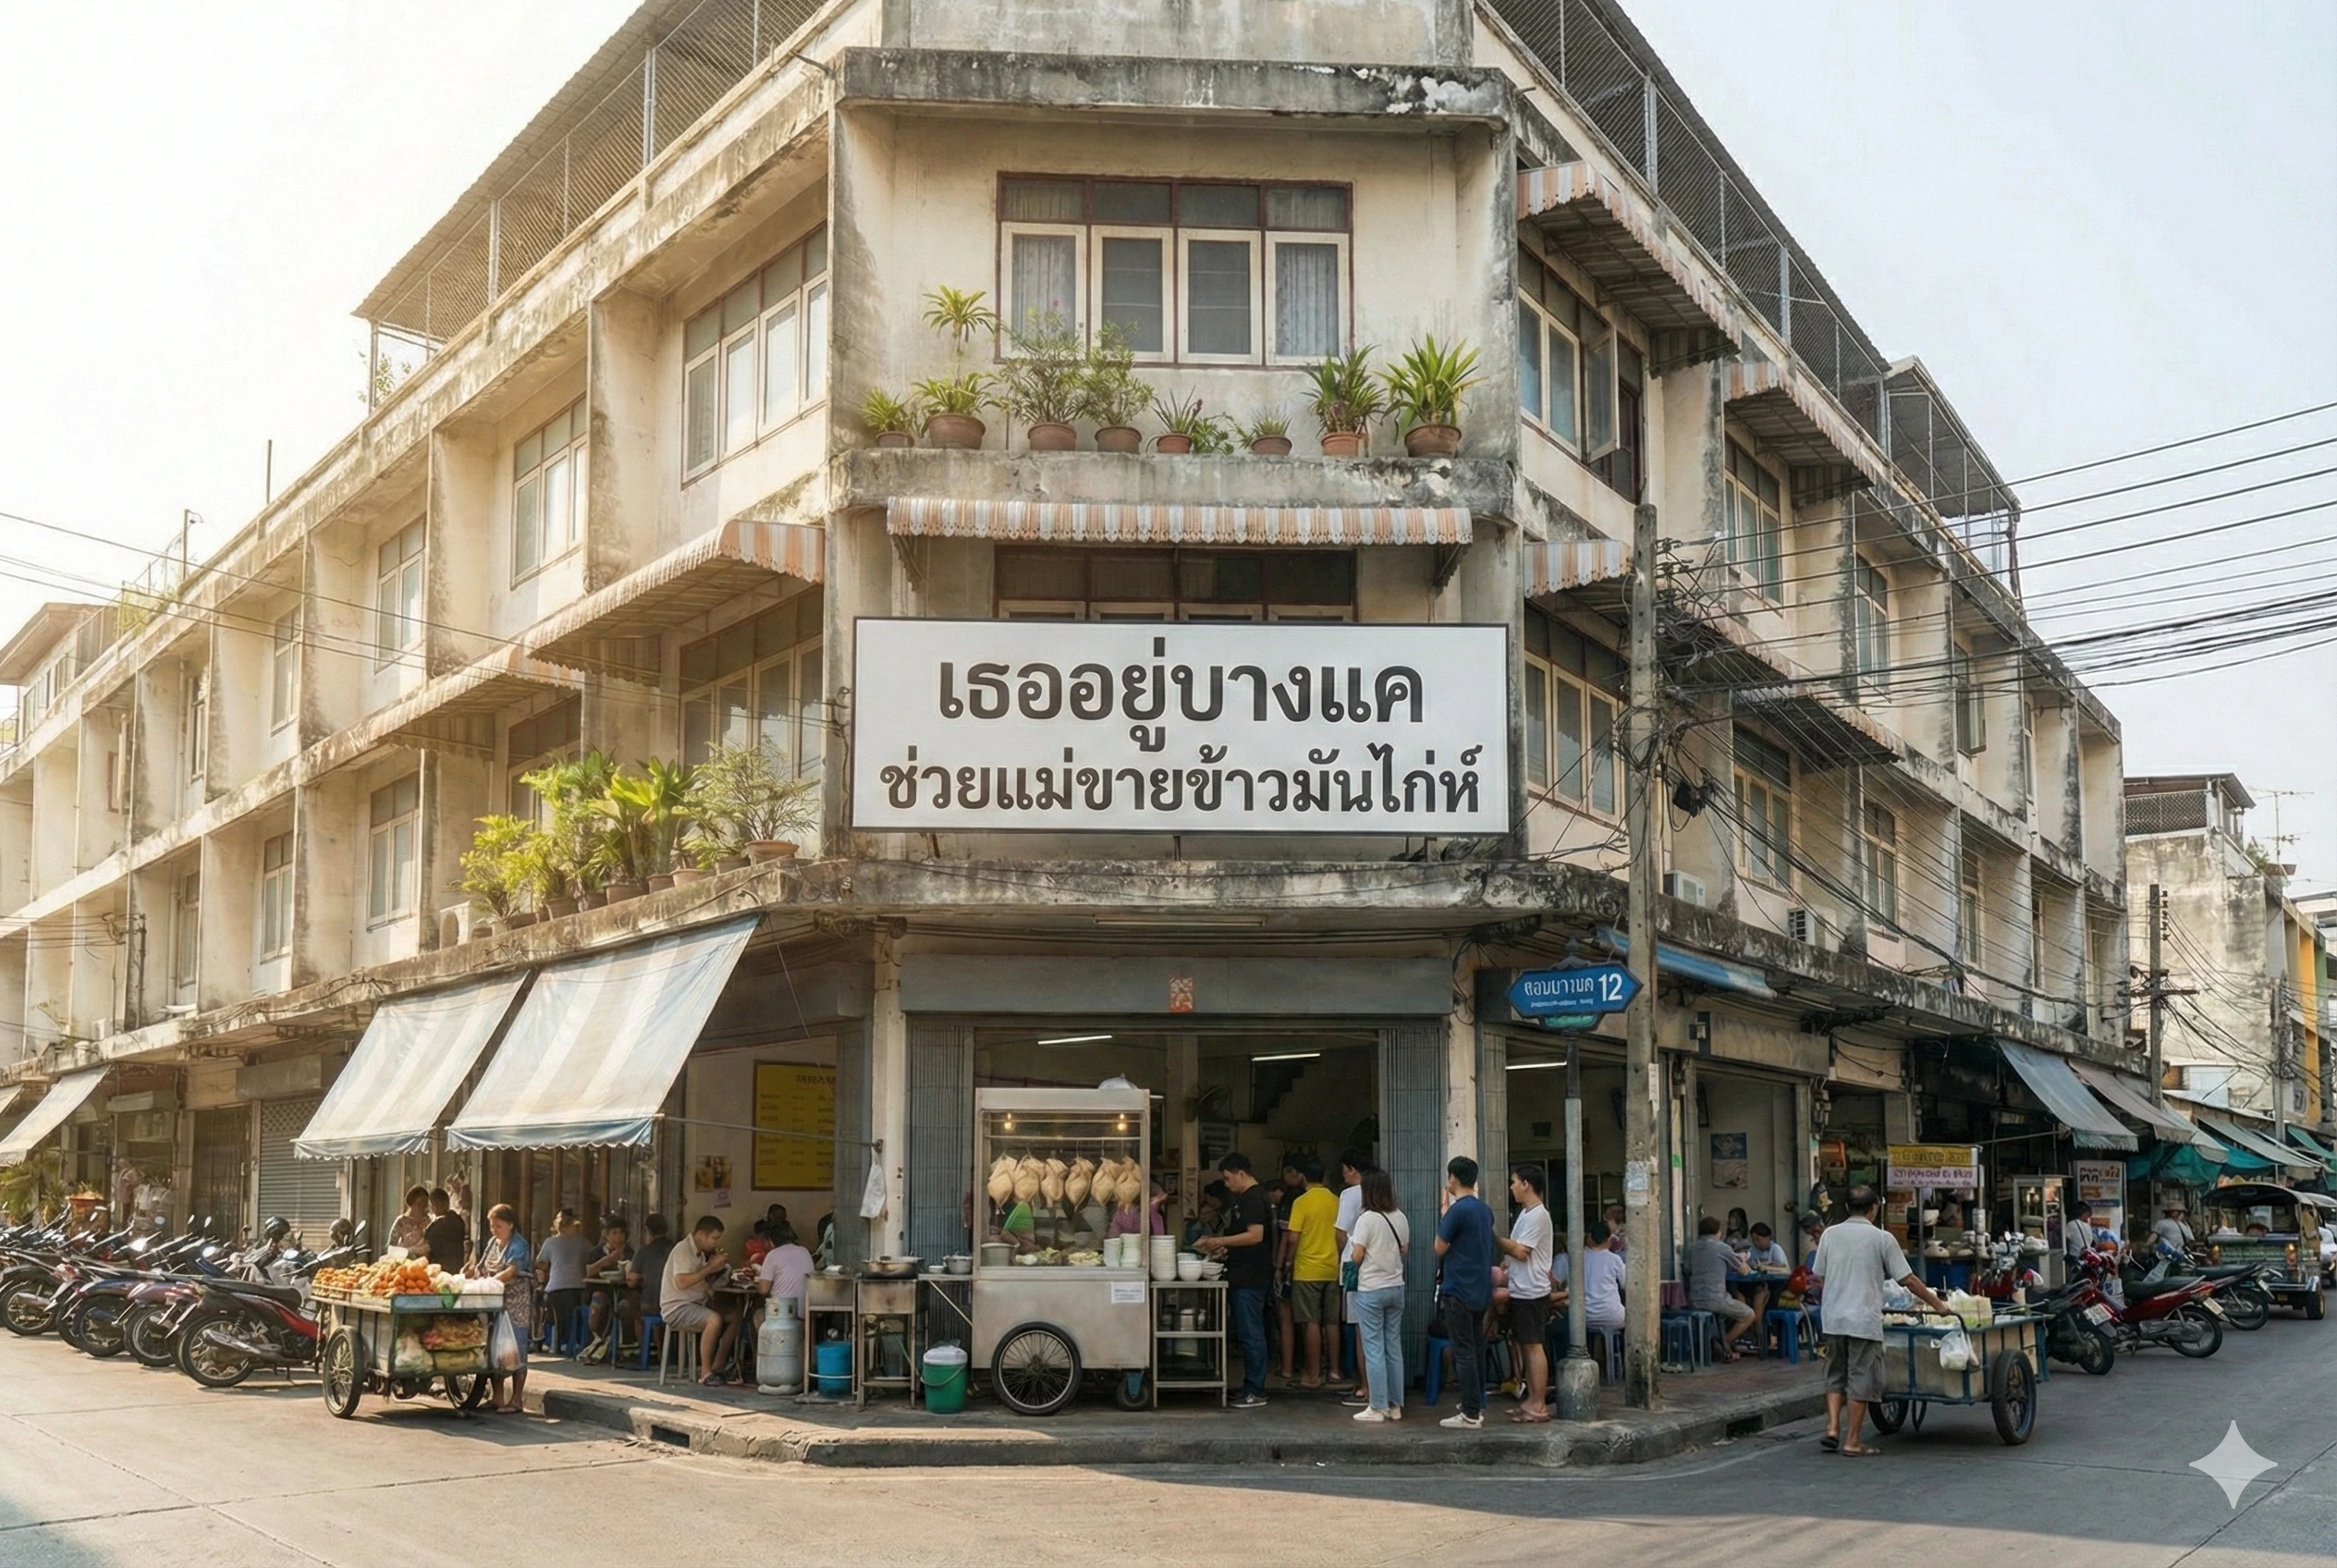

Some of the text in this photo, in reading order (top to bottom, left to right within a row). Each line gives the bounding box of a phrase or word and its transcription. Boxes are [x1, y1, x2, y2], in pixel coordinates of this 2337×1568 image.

[939, 636, 1423, 753] เธออยู่บางแค
[880, 742, 1483, 813] ช่วยแม่ขายข้าวมันไก่ห์
[1598, 973, 1622, 1001] 12
